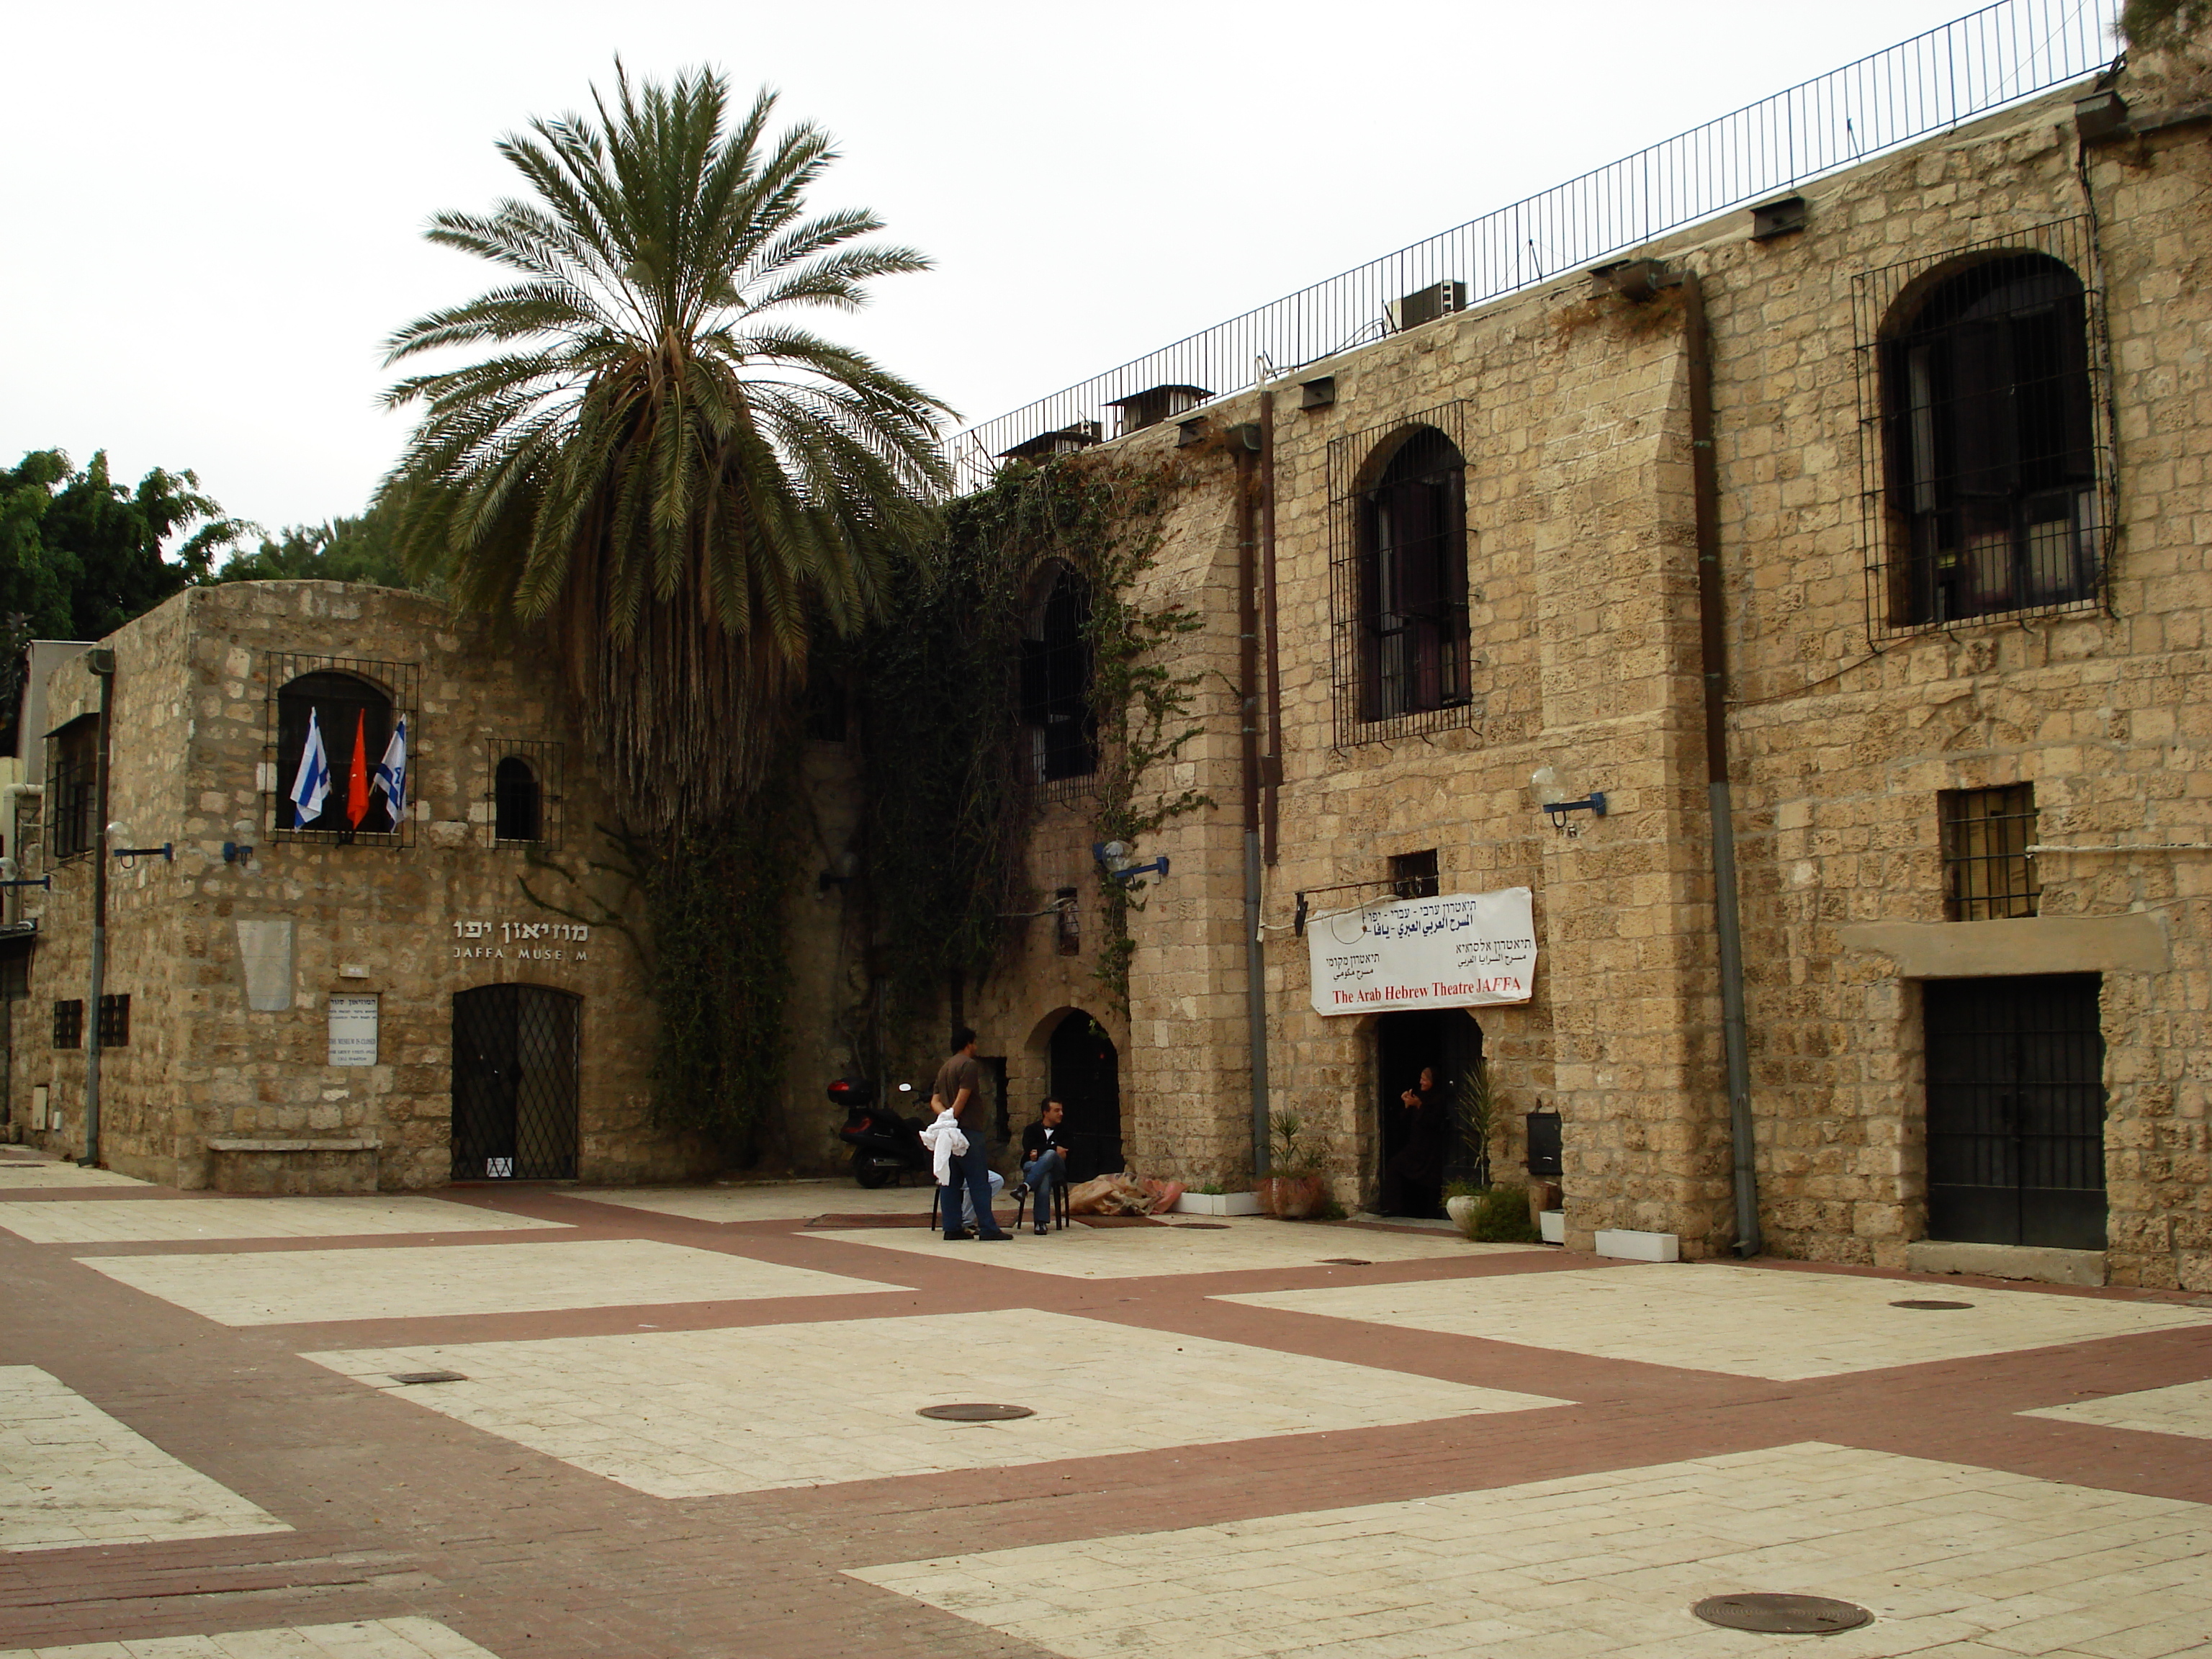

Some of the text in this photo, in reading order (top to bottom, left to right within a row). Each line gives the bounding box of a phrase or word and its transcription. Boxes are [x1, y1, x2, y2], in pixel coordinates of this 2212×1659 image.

[1390, 908, 1410, 919] עברי
[1420, 905, 1440, 916] ערבי
[1443, 901, 1476, 917] תיאטרון
[1368, 912, 1381, 922] יפו
[453, 920, 588, 944] מוזיאון יפו
[1374, 922, 1390, 939] يافا
[1398, 920, 1421, 938] العبري
[1422, 917, 1448, 937] العربي
[454, 948, 504, 958] JAFFA
[1493, 939, 1532, 954] תיאטרון
[1326, 953, 1380, 969] תיאטרון מקומי
[1505, 954, 1527, 966] مسرح
[1357, 968, 1373, 980] مسرح
[1333, 976, 1521, 1004] The Arab Hebrew Theatre JAFFA
